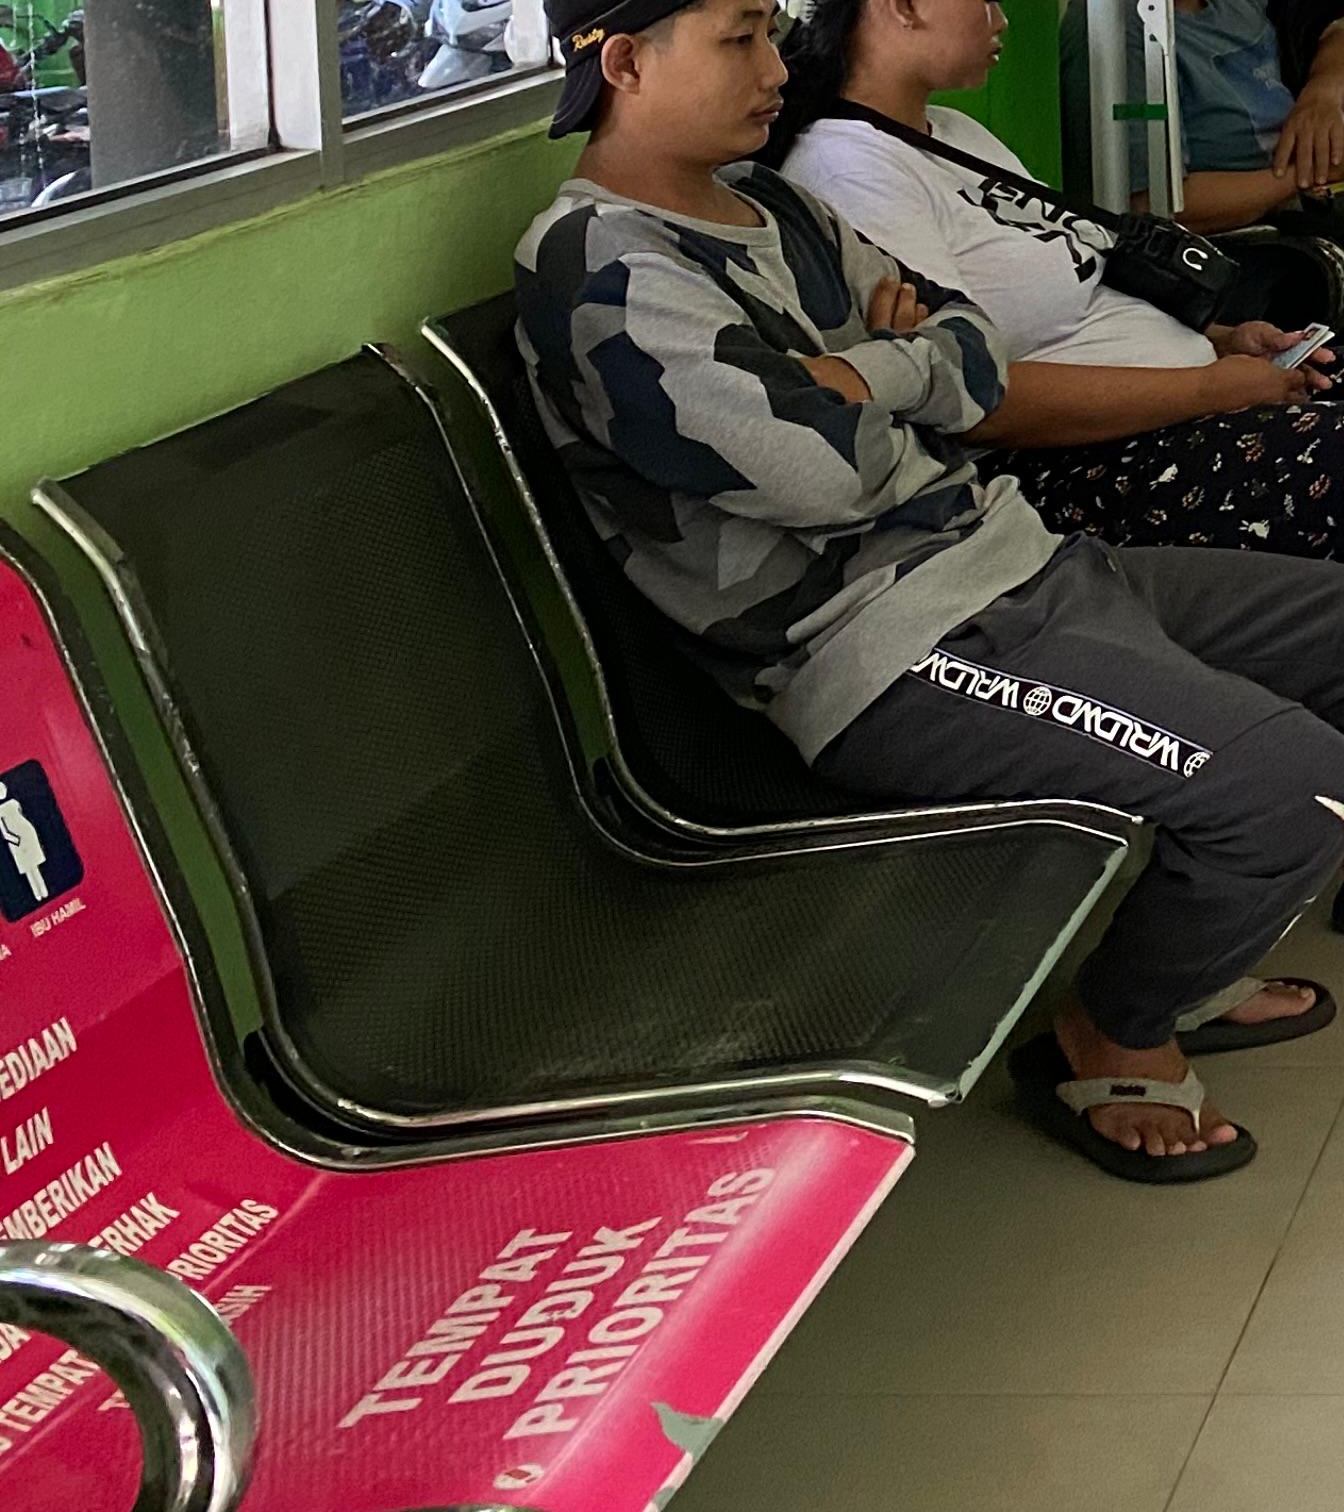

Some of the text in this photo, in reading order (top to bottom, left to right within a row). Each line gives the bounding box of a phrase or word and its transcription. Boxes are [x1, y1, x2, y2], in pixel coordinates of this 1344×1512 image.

[30, 897, 87, 938] IBU HAMIL
[0, 1106, 53, 1175] LAIN
[166, 1199, 279, 1280] RIORITAS
[502, 1167, 775, 1440] PRIORITAS
[338, 1228, 573, 1428] TEMPAT
[448, 1216, 661, 1404] DUDUK
